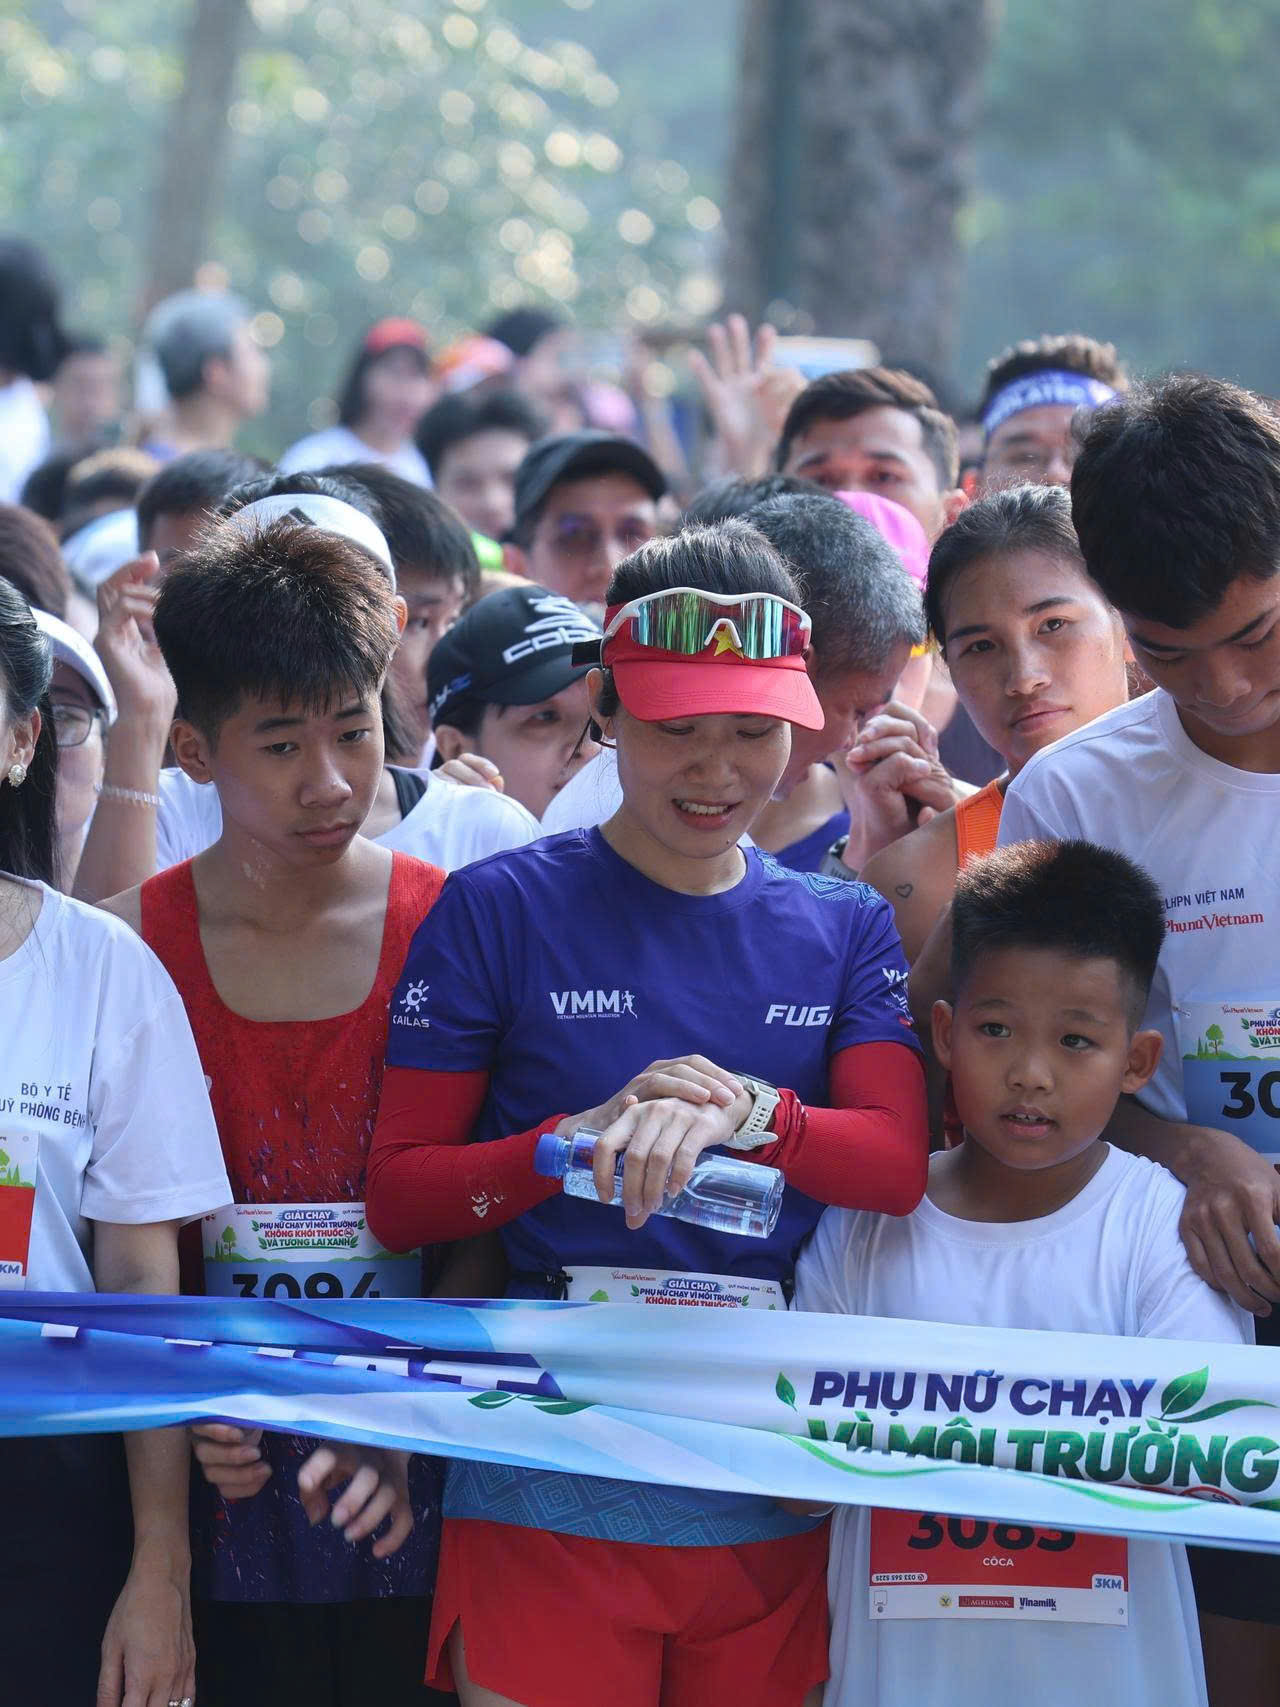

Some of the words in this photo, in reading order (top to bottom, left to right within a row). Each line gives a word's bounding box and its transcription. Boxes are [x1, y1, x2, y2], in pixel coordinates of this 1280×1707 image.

[1195, 890, 1216, 905] VIỆT
[1220, 887, 1245, 901] NAM
[549, 989, 620, 1015] VMM
[764, 1004, 834, 1027] FUG
[21, 1082, 38, 1098] BỘ
[43, 1085, 52, 1097] Y
[57, 1083, 72, 1101] TẾ
[20, 1101, 61, 1122] PHÒNG
[809, 1371, 917, 1417] PHỤ
[924, 1369, 1004, 1413] NỮ
[1009, 1378, 1157, 1425] CHẠY
[1008, 1418, 1279, 1493] TRƯỜNG
[982, 1556, 1015, 1567] CÔCA
[1094, 1577, 1122, 1590] 3KM
[1019, 1597, 1057, 1608] Vinamilk
